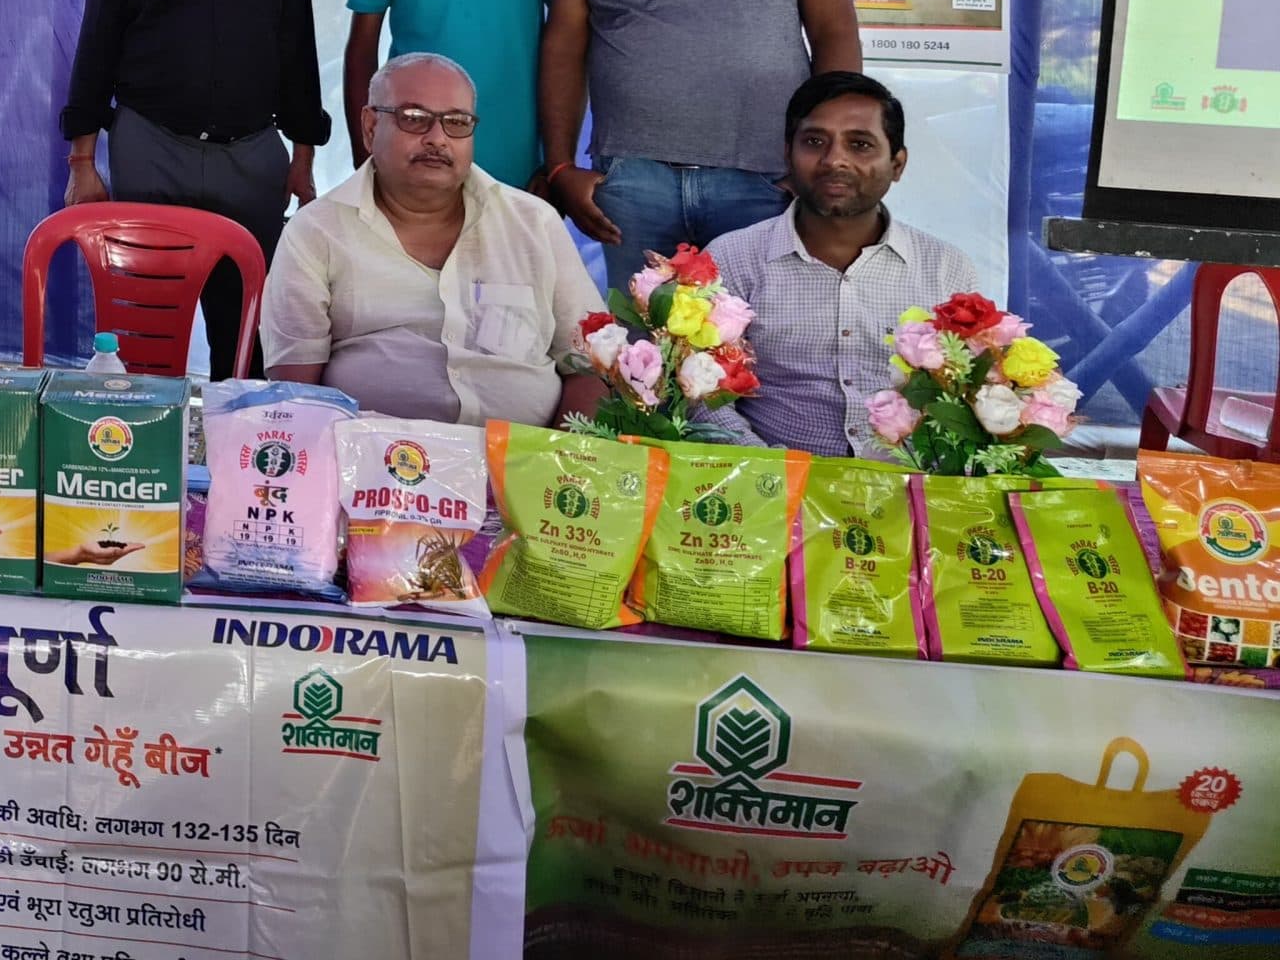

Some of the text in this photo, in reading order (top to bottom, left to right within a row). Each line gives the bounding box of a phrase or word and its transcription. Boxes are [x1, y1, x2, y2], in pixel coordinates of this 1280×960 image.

[871, 40, 950, 51] 1800 180 5244
[257, 431, 293, 442] PARAS
[57, 471, 168, 500] Mender
[248, 506, 294, 524] N P K
[352, 487, 468, 520] PROSPO-GR
[286, 537, 296, 545] 19
[540, 519, 601, 546] Zn 33%
[680, 532, 747, 551] Zn 33%
[845, 556, 875, 572] B-20
[971, 568, 1006, 581] B-20
[1087, 581, 1119, 594] B-20
[213, 618, 458, 665] INDORAMA
[282, 718, 381, 756] शक्तिमान
[4, 728, 74, 764] उन्नत
[84, 725, 141, 789] गेहूँ
[1195, 774, 1226, 792] 20
[667, 775, 858, 835] शक्तिमान
[27, 805, 88, 832] अवधि:
[95, 815, 164, 838] लगभग
[172, 821, 259, 843] 132-135
[265, 821, 300, 849] दिन
[81, 855, 149, 880] लगभग
[157, 861, 182, 881] 90
[190, 860, 247, 889] से.मी.
[772, 858, 844, 880] उपज
[856, 851, 957, 886] बढ़ाओ
[28, 897, 61, 922] भूरा
[68, 900, 120, 928] रतुआ
[126, 902, 206, 932] प्रतिरोधी
